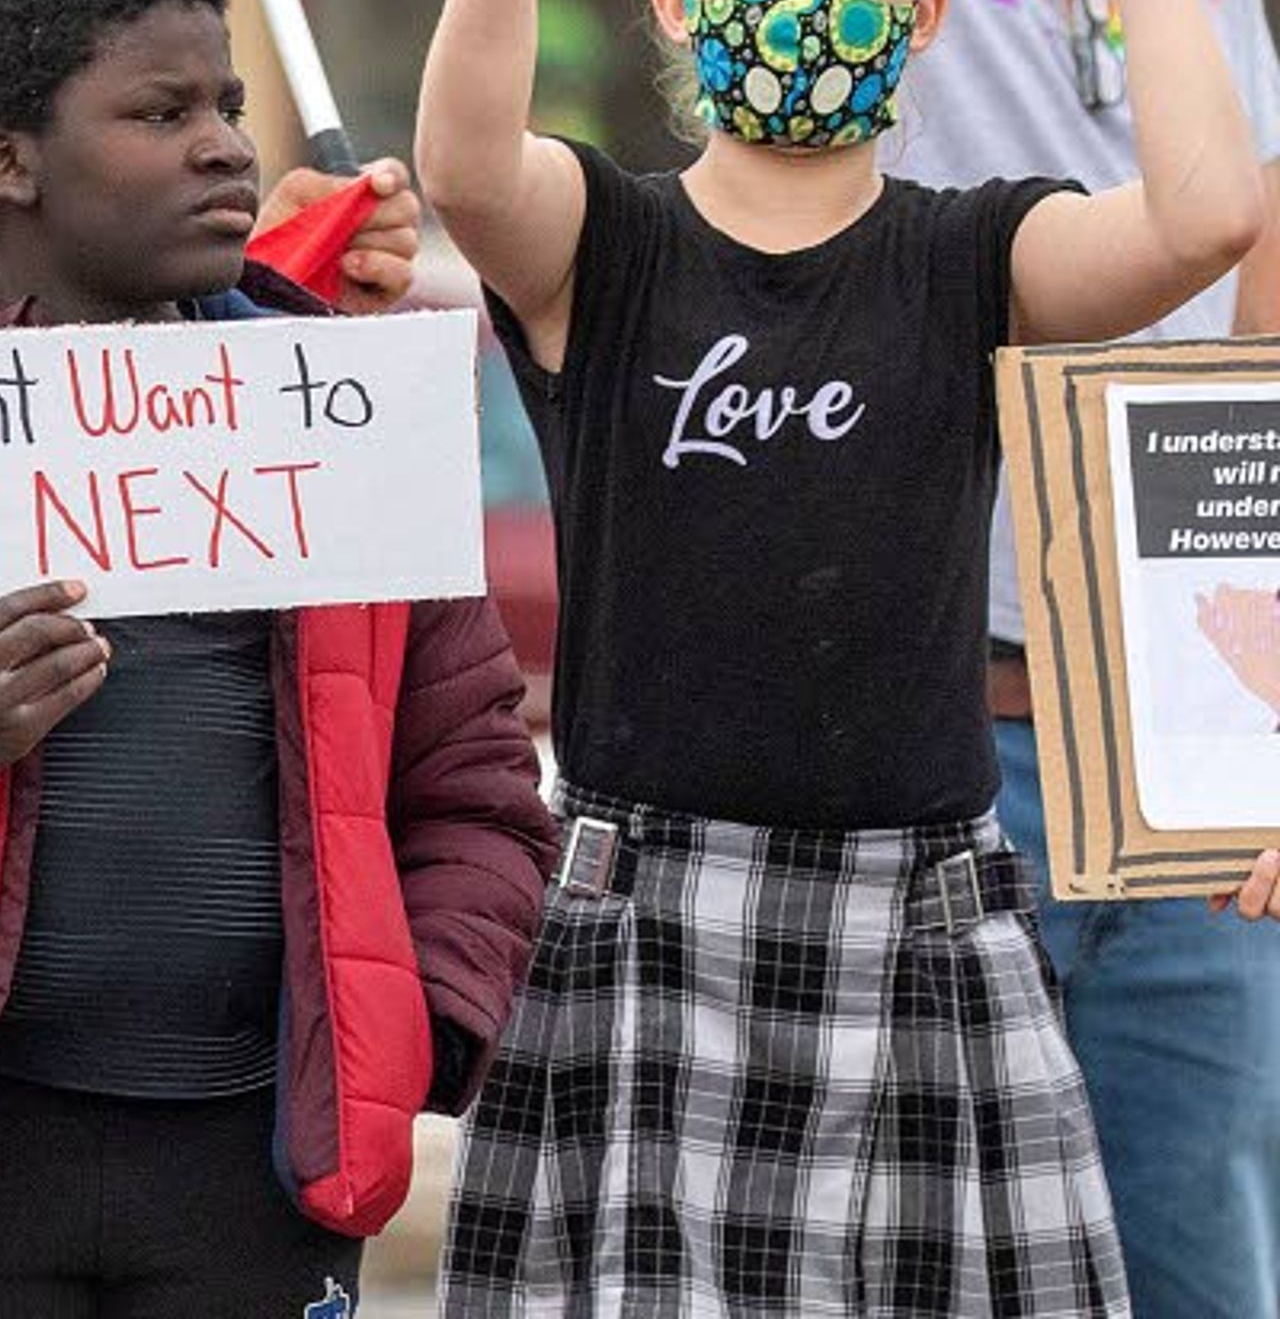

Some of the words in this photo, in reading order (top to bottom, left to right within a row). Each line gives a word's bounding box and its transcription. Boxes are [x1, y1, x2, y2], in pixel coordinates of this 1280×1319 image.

[67, 343, 244, 437] Want
[279, 343, 373, 429] to
[654, 334, 865, 467] Love
[1147, 432, 1158, 453] I
[1162, 430, 1280, 453] underst
[1213, 461, 1266, 485] will
[34, 461, 321, 576] NEXT
